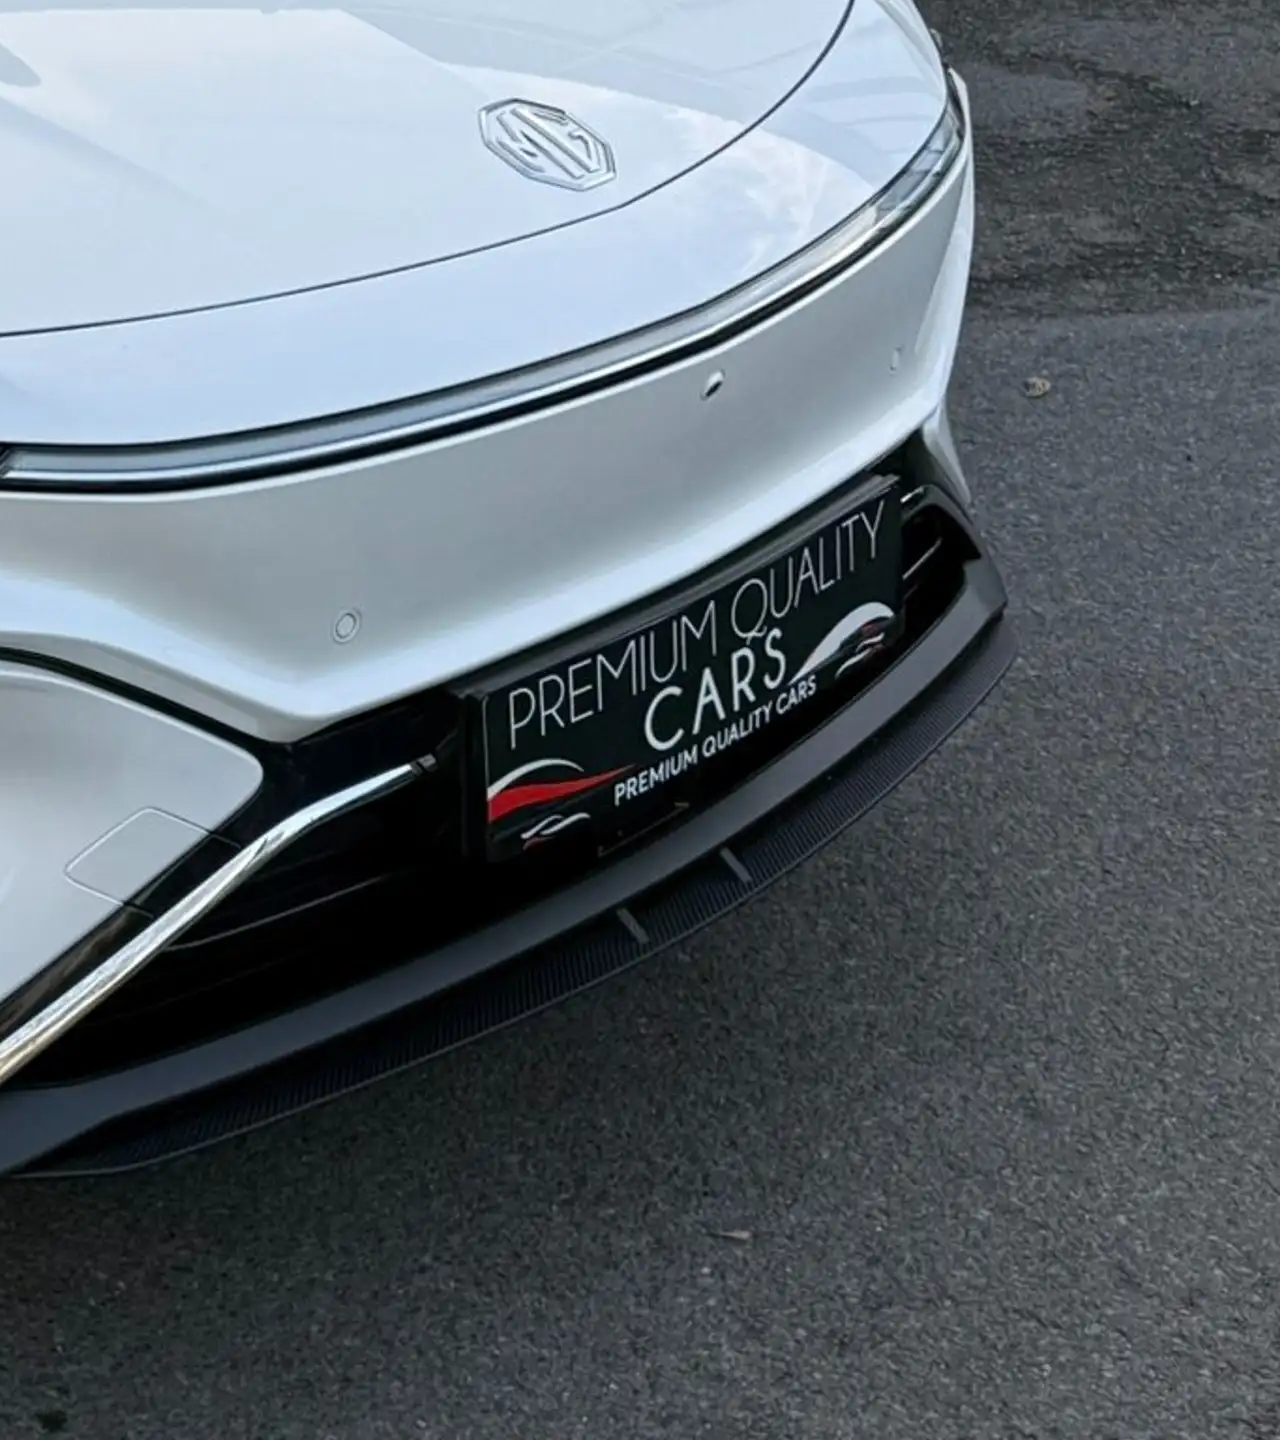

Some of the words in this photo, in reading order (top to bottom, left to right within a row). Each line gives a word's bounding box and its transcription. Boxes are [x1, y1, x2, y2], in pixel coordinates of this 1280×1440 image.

[492, 106, 604, 182] MG
[509, 599, 717, 750] PREMIUM
[730, 498, 885, 645] QUALITY
[614, 744, 698, 807] PREMIUM
[702, 700, 773, 758] QUALITY
[775, 674, 818, 715] CARS
[643, 627, 787, 751] CARS
